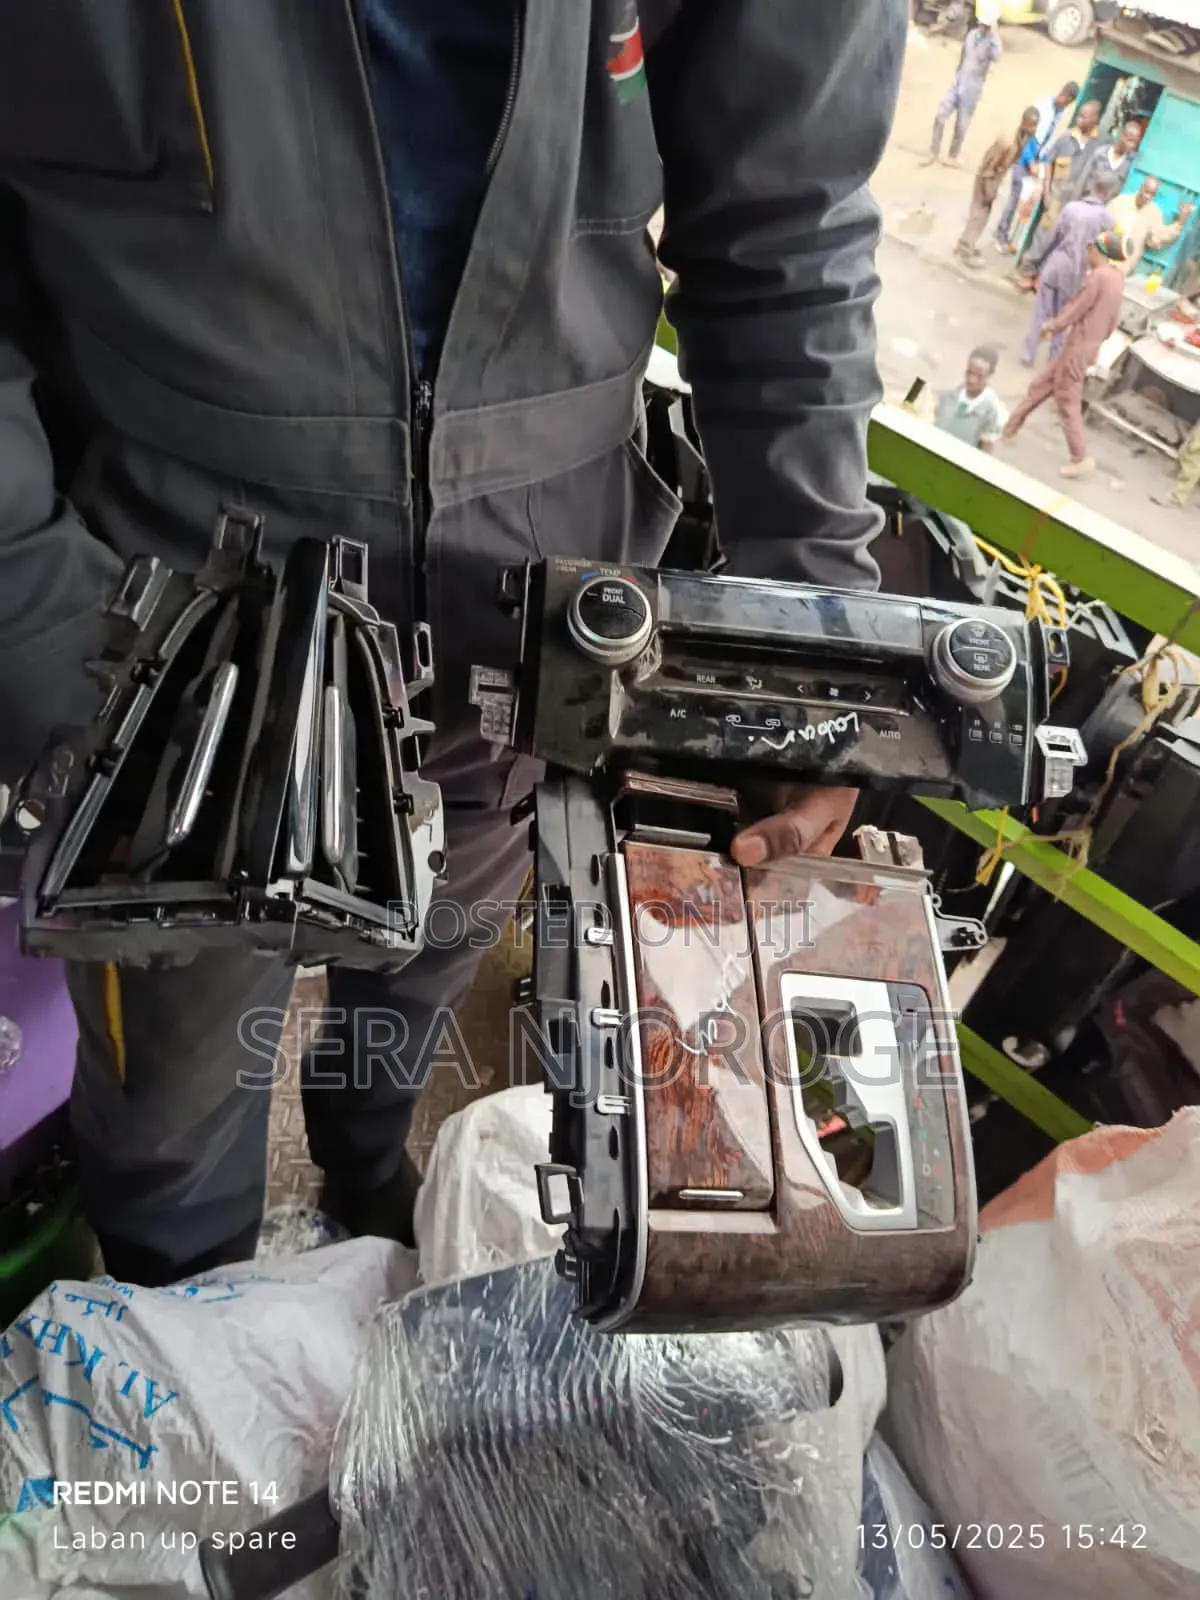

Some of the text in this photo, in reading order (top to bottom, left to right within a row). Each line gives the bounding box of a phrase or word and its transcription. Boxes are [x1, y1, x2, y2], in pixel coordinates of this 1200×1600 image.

[600, 567, 622, 577] TEMP
[602, 593, 626, 604] DUAL
[696, 674, 716, 684] REAR
[670, 708, 687, 719] A/C
[879, 729, 901, 740] AUTO
